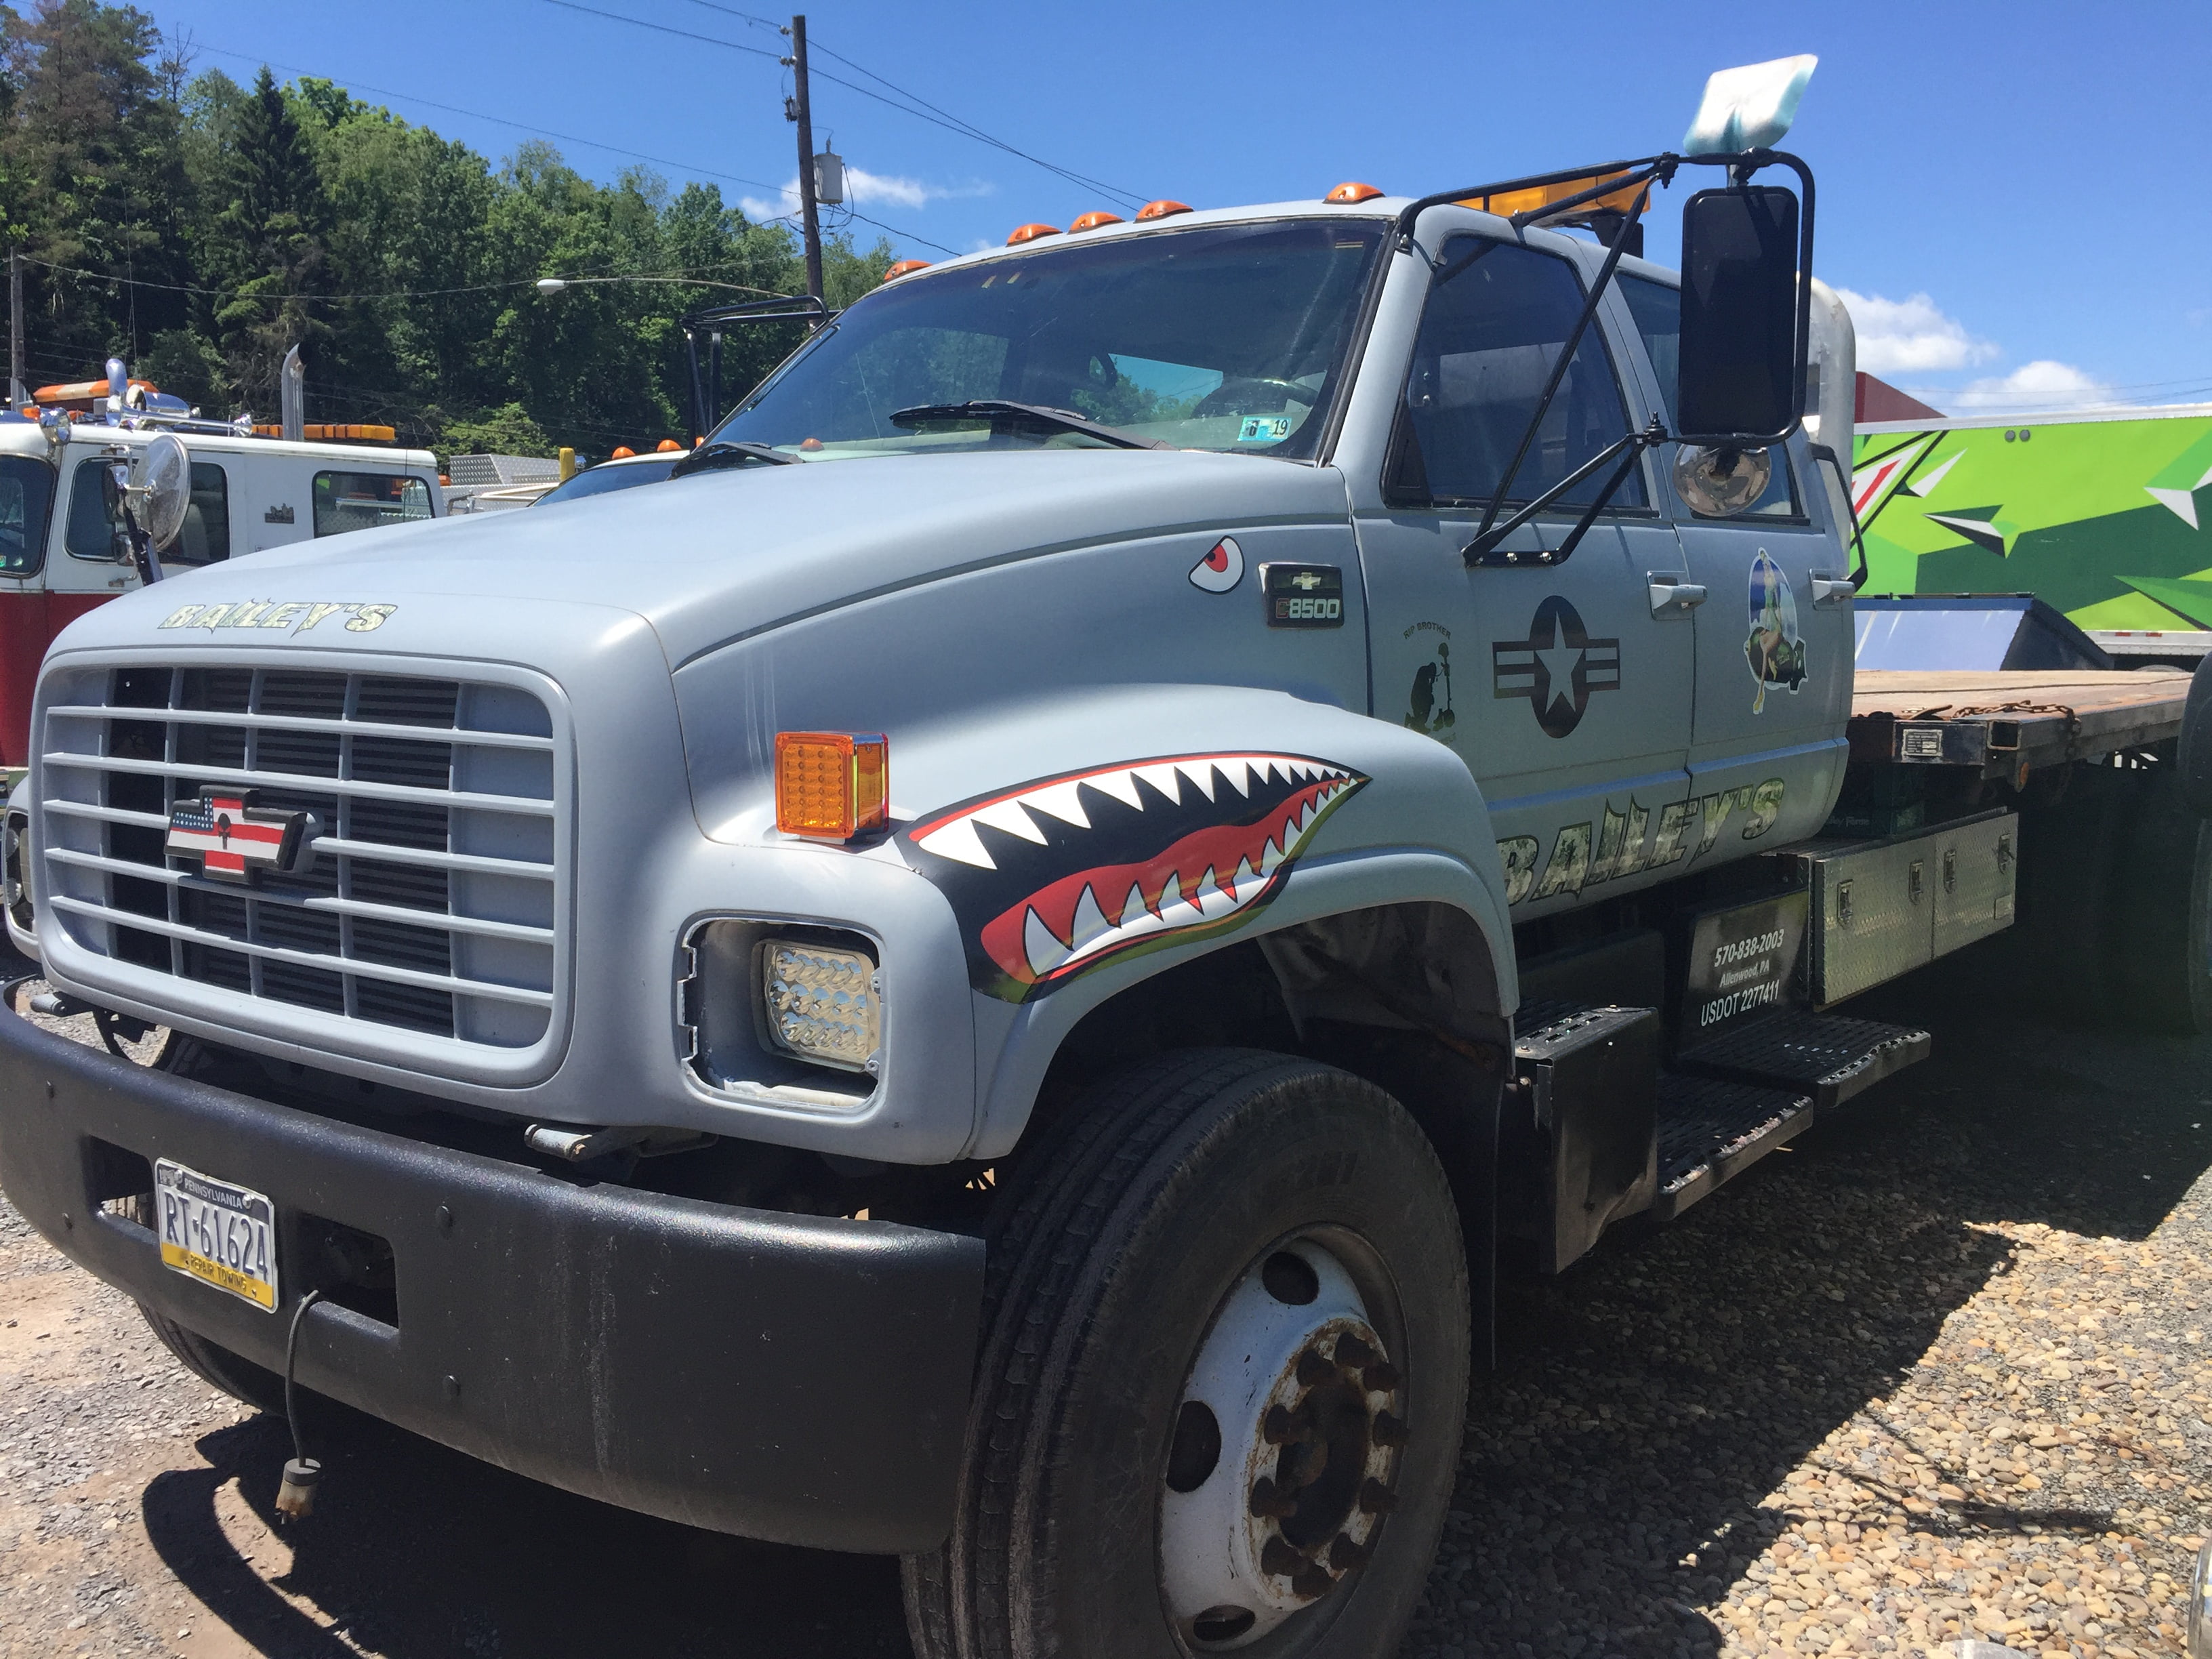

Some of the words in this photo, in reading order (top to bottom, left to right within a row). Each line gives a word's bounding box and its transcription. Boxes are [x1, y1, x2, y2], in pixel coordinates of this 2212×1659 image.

[1273, 419, 1288, 436] 19
[157, 598, 398, 638] BAILEY'S
[1404, 626, 1414, 639] RIP
[1417, 621, 1451, 640] BROTHER
[1496, 777, 1784, 907] BAILEY'S
[1714, 928, 1784, 967] 570-838-2003
[1719, 962, 1758, 988] Allenwood,
[1759, 960, 1770, 977] PA
[1701, 992, 1740, 1027] USDOT
[1740, 979, 1780, 1012] 2277411
[184, 1178, 243, 1209] PENNSYLVANIA
[190, 1252, 214, 1277] REPAIR
[217, 1265, 247, 1292] TOWING
